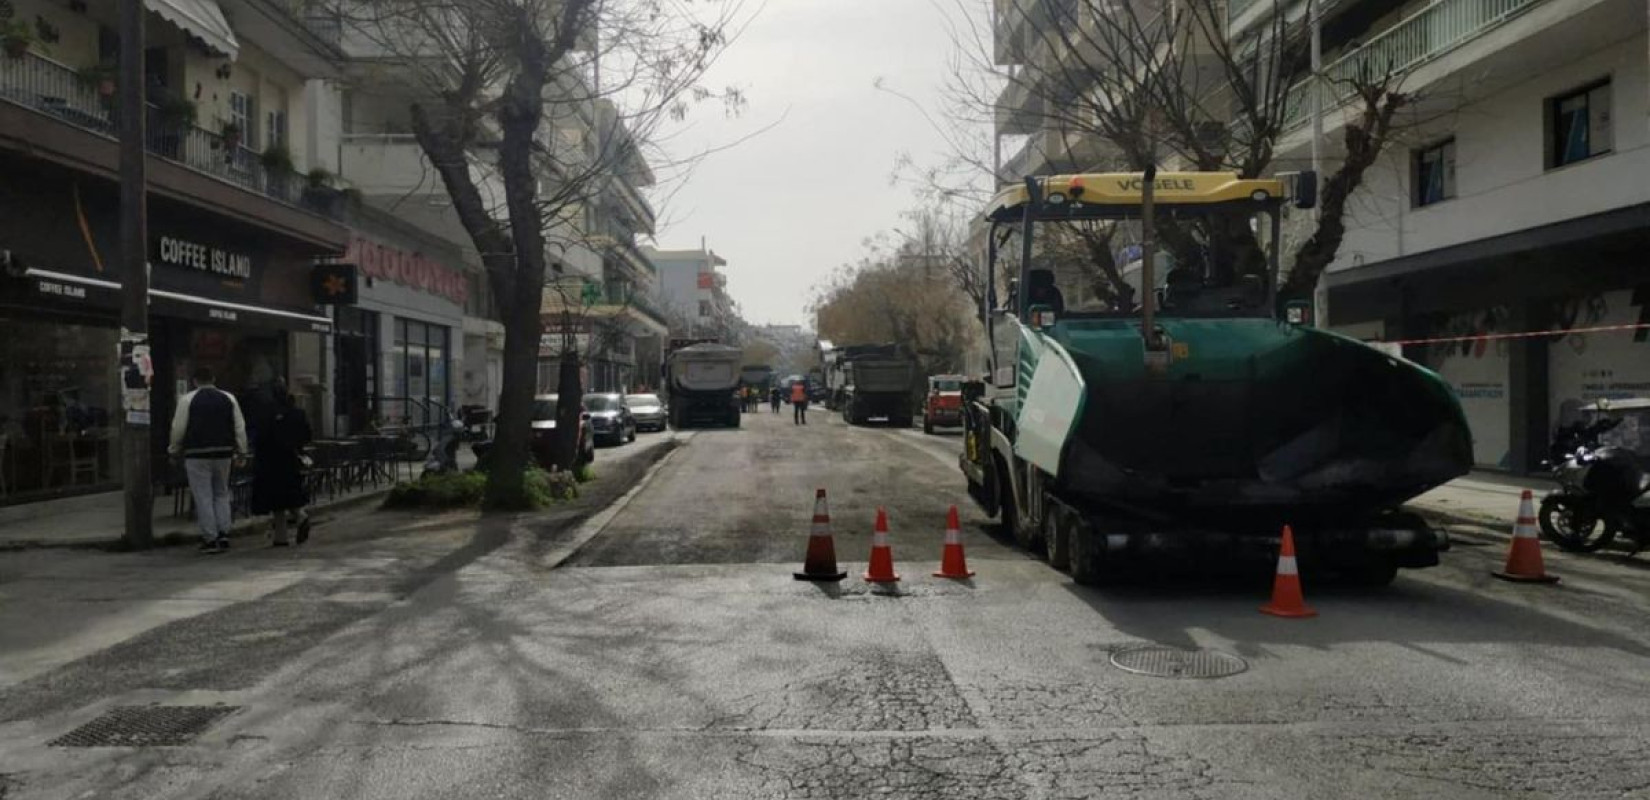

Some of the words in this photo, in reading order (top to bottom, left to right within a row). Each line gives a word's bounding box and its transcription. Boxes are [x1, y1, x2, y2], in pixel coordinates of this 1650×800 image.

[160, 236, 207, 271] COFFEE
[211, 248, 251, 278] ISLAND
[39, 281, 63, 295] COFFEE
[64, 285, 86, 298] ISLAND
